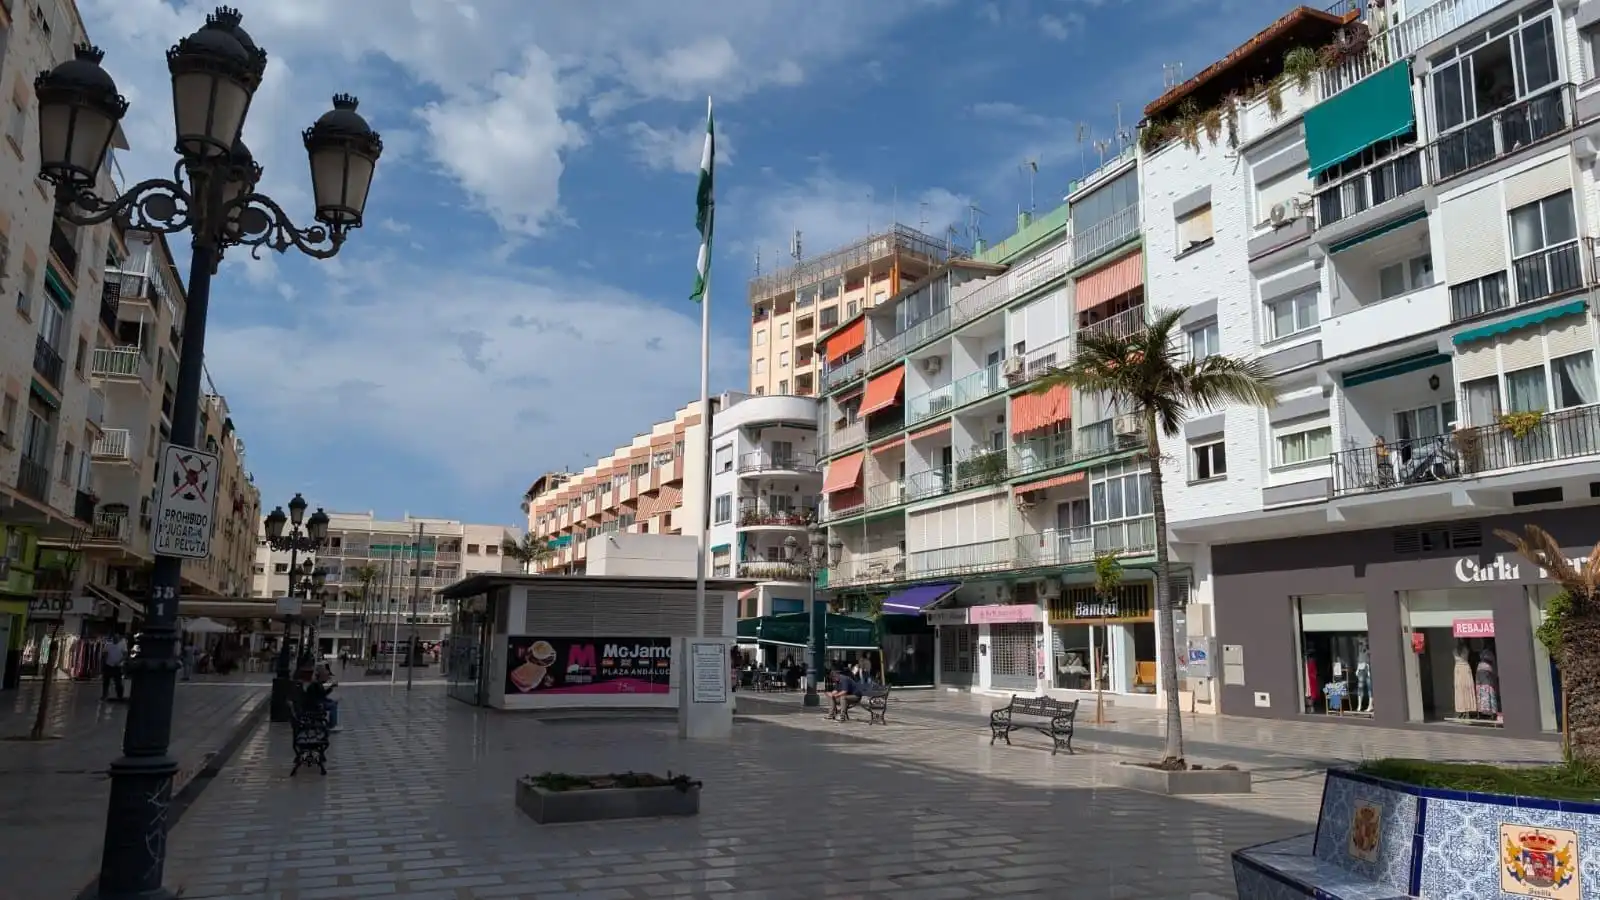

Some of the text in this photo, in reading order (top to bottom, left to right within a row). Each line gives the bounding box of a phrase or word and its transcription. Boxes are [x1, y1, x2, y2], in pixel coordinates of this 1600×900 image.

[164, 508, 208, 527] PROHIBIDO
[159, 536, 170, 548] LA
[1456, 623, 1495, 633] REBAJAS
[602, 668, 630, 676] PLAZA
